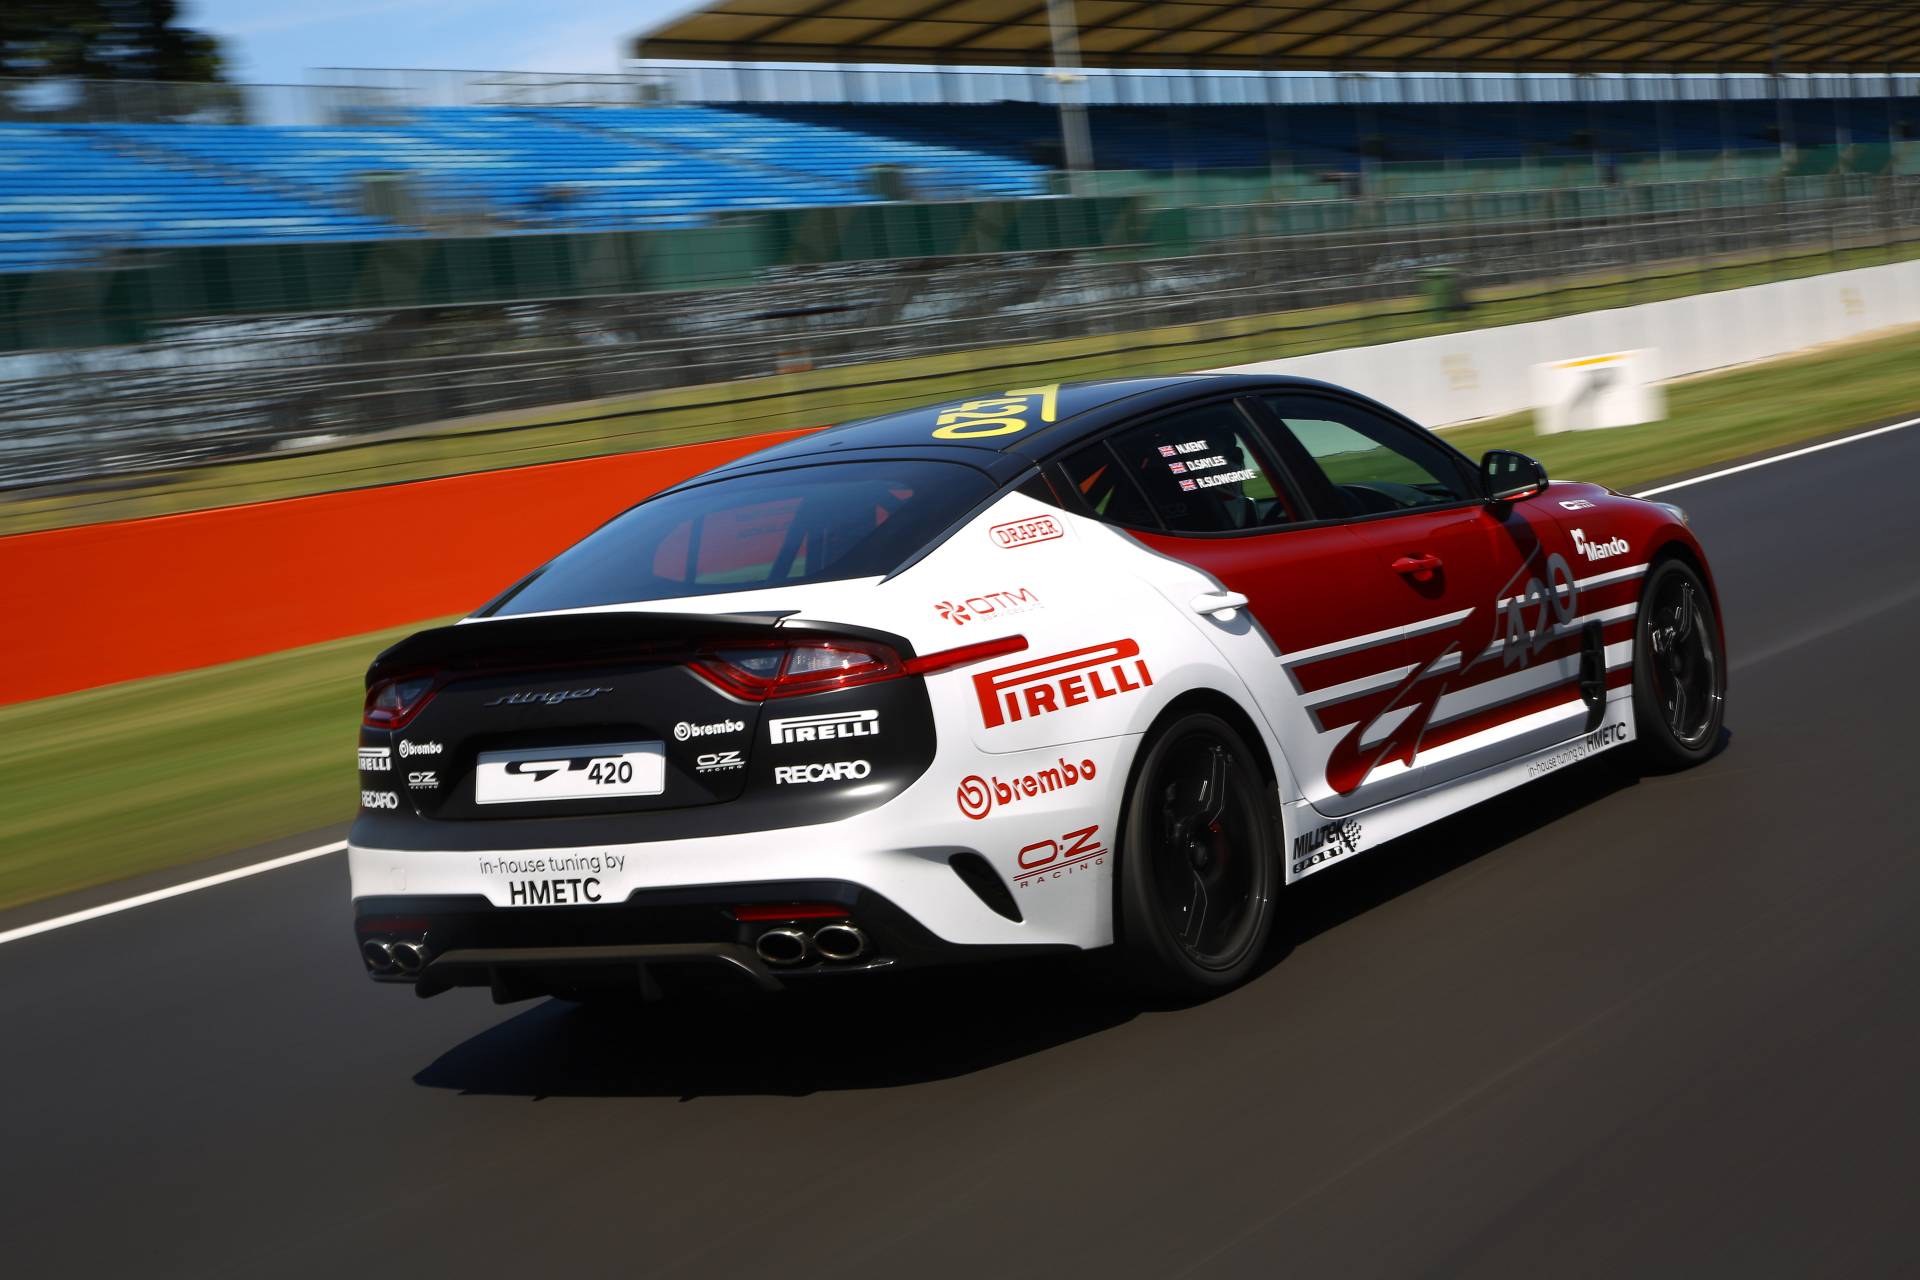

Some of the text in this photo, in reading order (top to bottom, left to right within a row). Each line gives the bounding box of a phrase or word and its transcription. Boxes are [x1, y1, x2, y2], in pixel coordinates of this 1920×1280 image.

[1175, 440, 1208, 454] N.KENT
[1185, 455, 1228, 471] D.SAYLES
[1196, 469, 1257, 488] R.SLOWGROVE
[996, 520, 1058, 544] DRAPER
[1584, 536, 1630, 561] Mando
[965, 588, 1039, 614] OTM
[1503, 553, 1577, 669] 420
[972, 638, 1154, 729] PIRELLI
[691, 719, 745, 737] brembo
[769, 710, 880, 744] PIRELLI
[1586, 721, 1627, 753] HMETC
[408, 741, 443, 755] brembo
[588, 761, 633, 785] 420
[699, 765, 743, 773] RACING
[774, 760, 871, 784] RECARO
[992, 757, 1096, 806] brembo
[361, 790, 399, 809] RECARO
[479, 851, 625, 874] in-house tuning by
[1294, 846, 1343, 874] SPORT
[1020, 858, 1103, 889] RACING
[509, 877, 602, 906] HMETC
